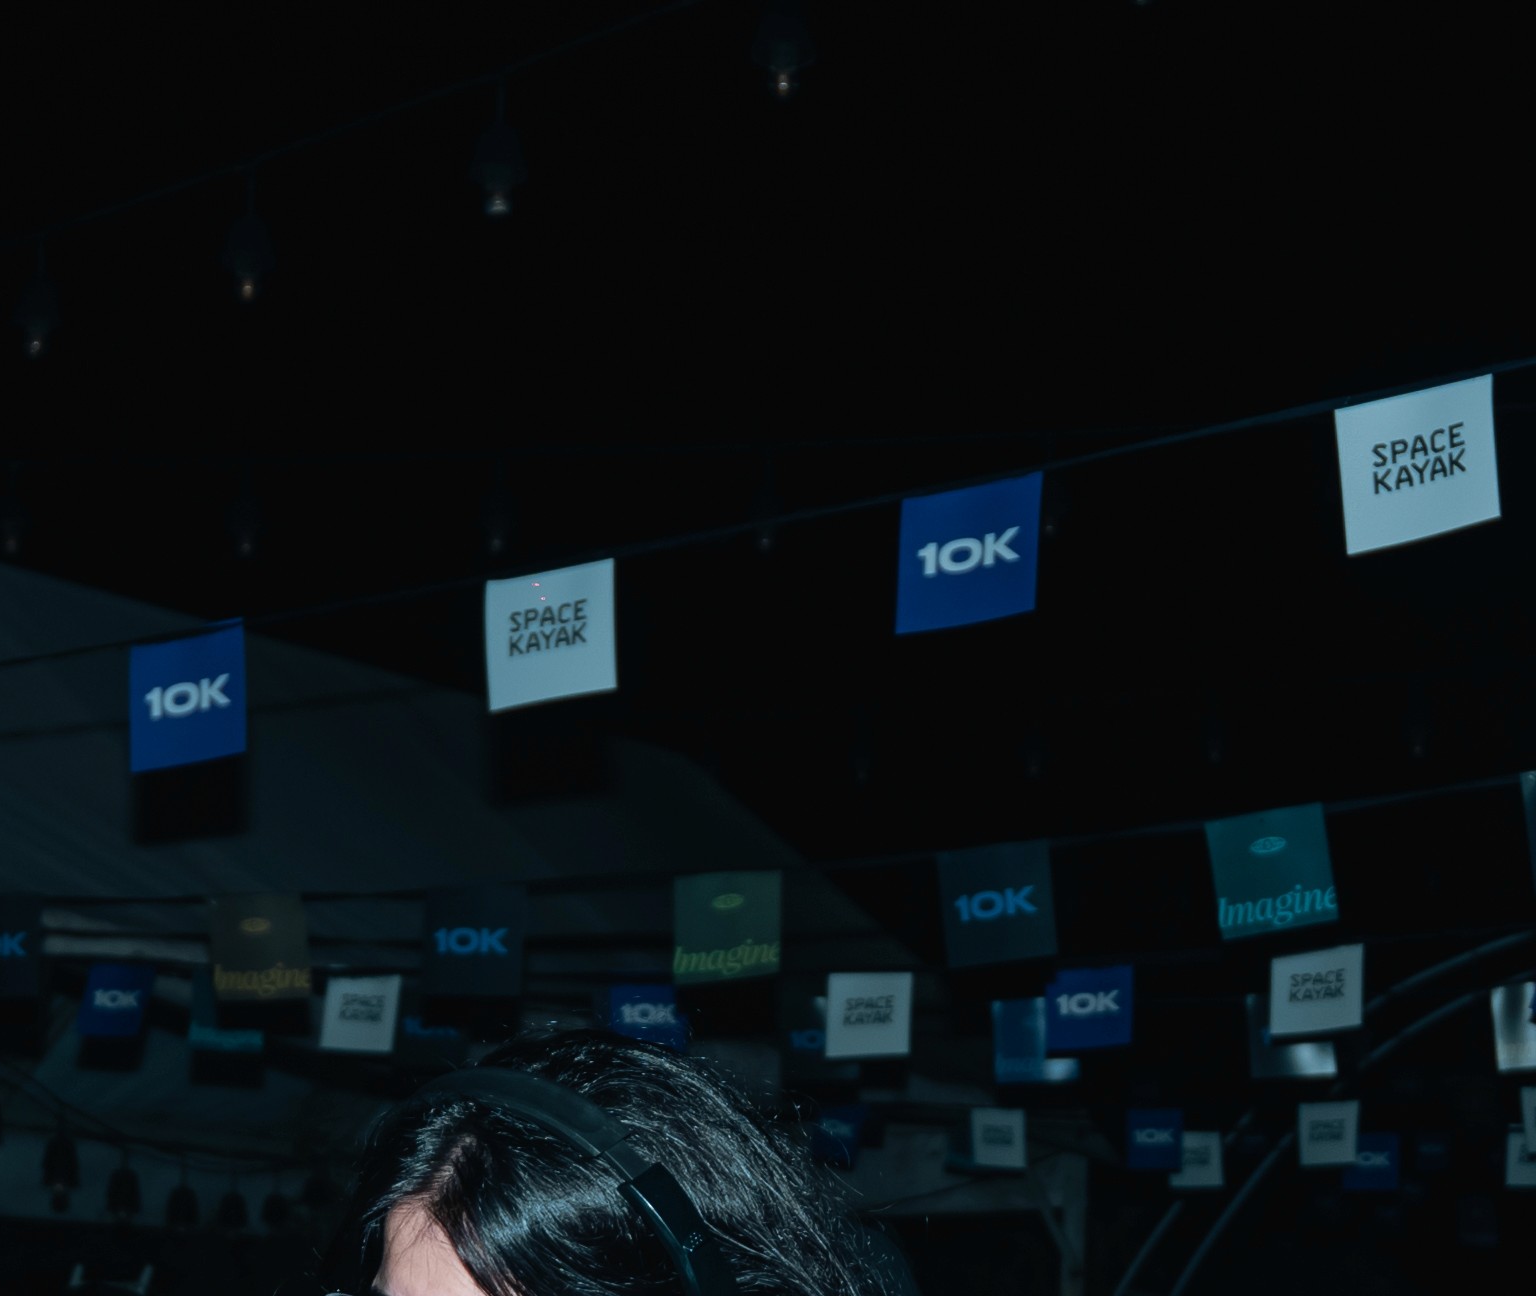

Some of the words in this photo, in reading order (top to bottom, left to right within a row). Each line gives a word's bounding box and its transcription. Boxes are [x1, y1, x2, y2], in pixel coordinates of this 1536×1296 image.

[1372, 422, 1467, 470] SPACE
[1372, 448, 1468, 497] KAYAK
[915, 525, 1022, 580] 10K
[508, 599, 588, 638] SPACE
[508, 621, 588, 660] KAYAK
[143, 671, 232, 721] 10K
[954, 884, 1039, 924] 10K
[1218, 884, 1338, 928] Imagine
[433, 927, 511, 957] 10K
[1289, 968, 1345, 988] SPACE
[1289, 984, 1345, 1003] KAYAK
[92, 988, 142, 1012] 10K
[619, 1002, 677, 1026] 10K
[1055, 990, 1121, 1017] 10K
[790, 1030, 824, 1051] 10
[1133, 1127, 1175, 1146] 10K
